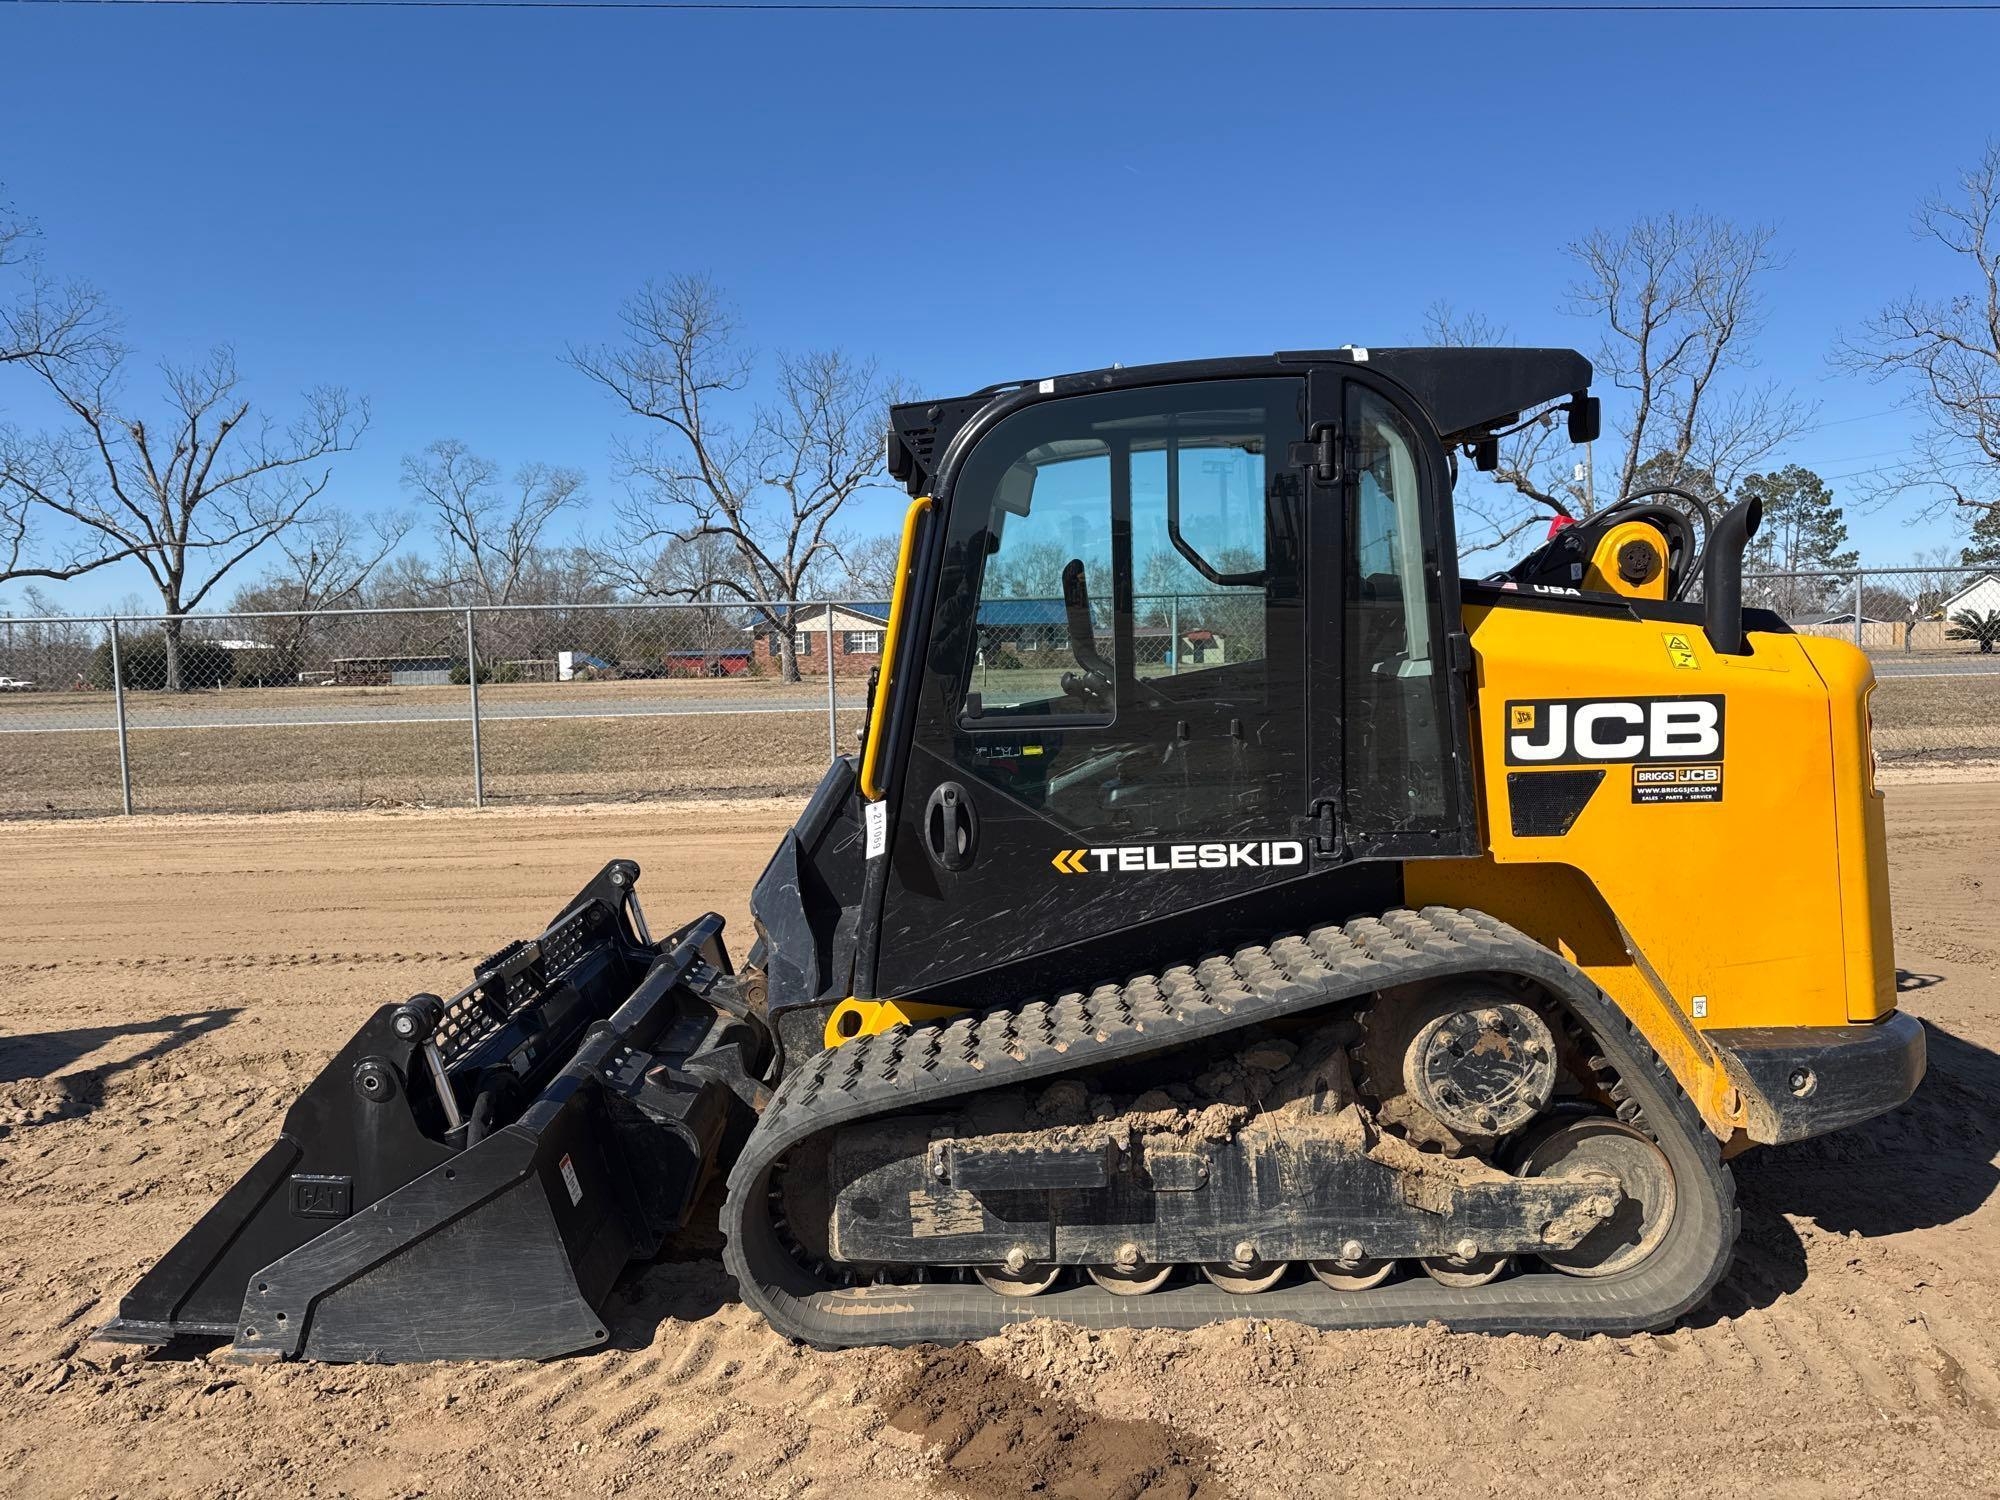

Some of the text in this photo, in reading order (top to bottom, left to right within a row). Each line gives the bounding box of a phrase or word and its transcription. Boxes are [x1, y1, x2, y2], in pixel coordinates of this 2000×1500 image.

[1533, 584, 1582, 597] USA
[1510, 700, 1720, 761] JCB
[1638, 769, 1718, 782] BRIGGS JCB
[1637, 786, 1718, 794] WWW.BRIGGSJCB.COM
[1090, 840, 1304, 873] TELESKID
